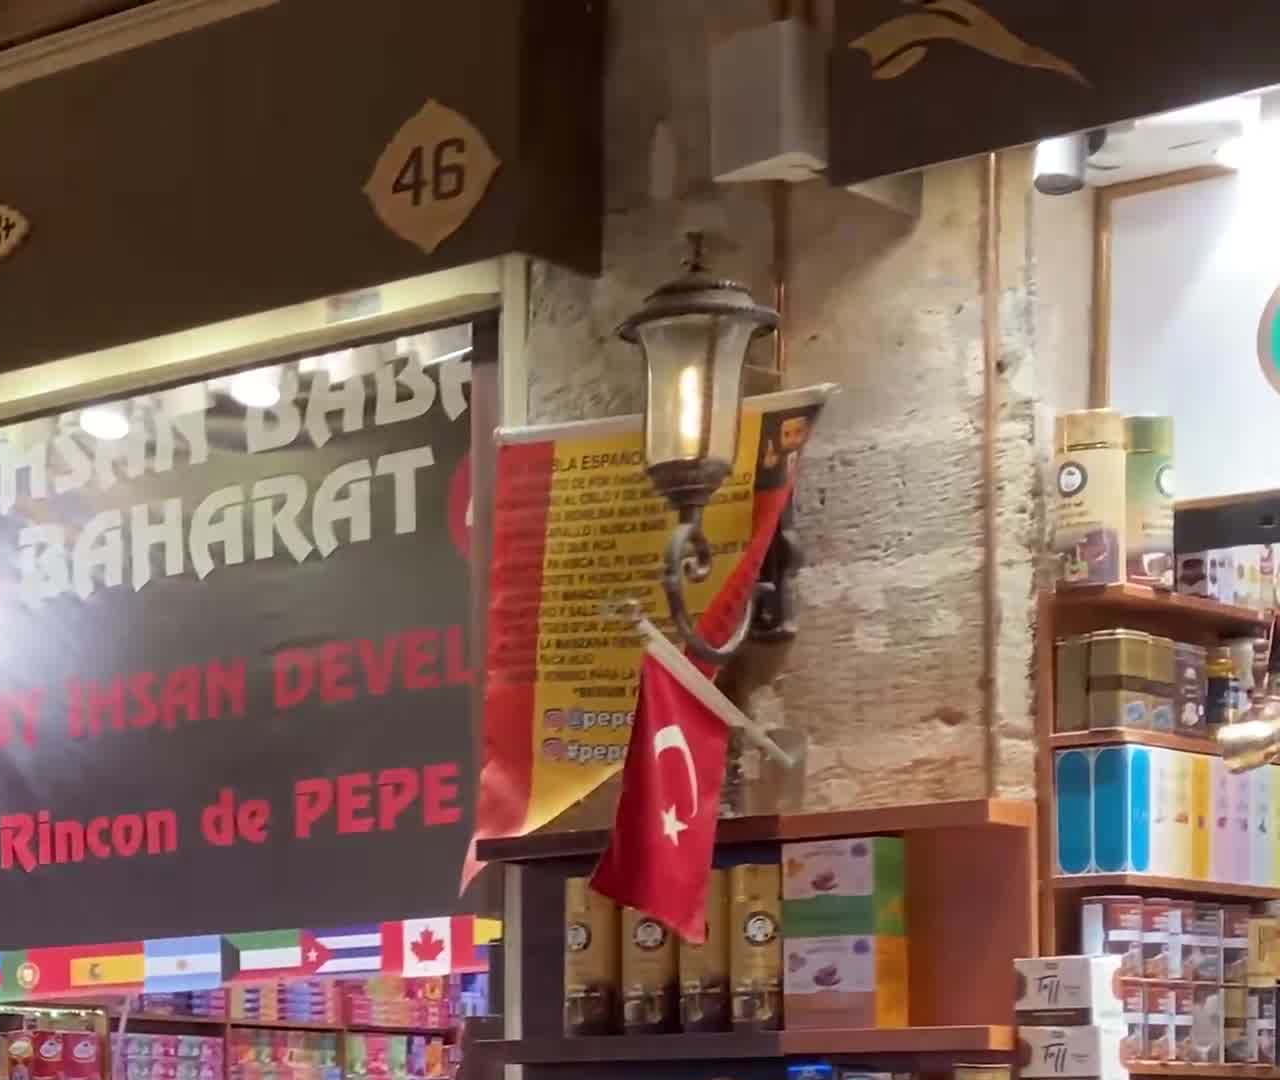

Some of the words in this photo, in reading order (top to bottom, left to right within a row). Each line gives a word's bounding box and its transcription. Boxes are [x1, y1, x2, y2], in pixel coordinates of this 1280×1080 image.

[390, 136, 467, 208] 46
[16, 446, 435, 602] BAHARAT
[0, 806, 177, 873] Rincon
[201, 786, 272, 846] de
[294, 761, 462, 839] PEPE
